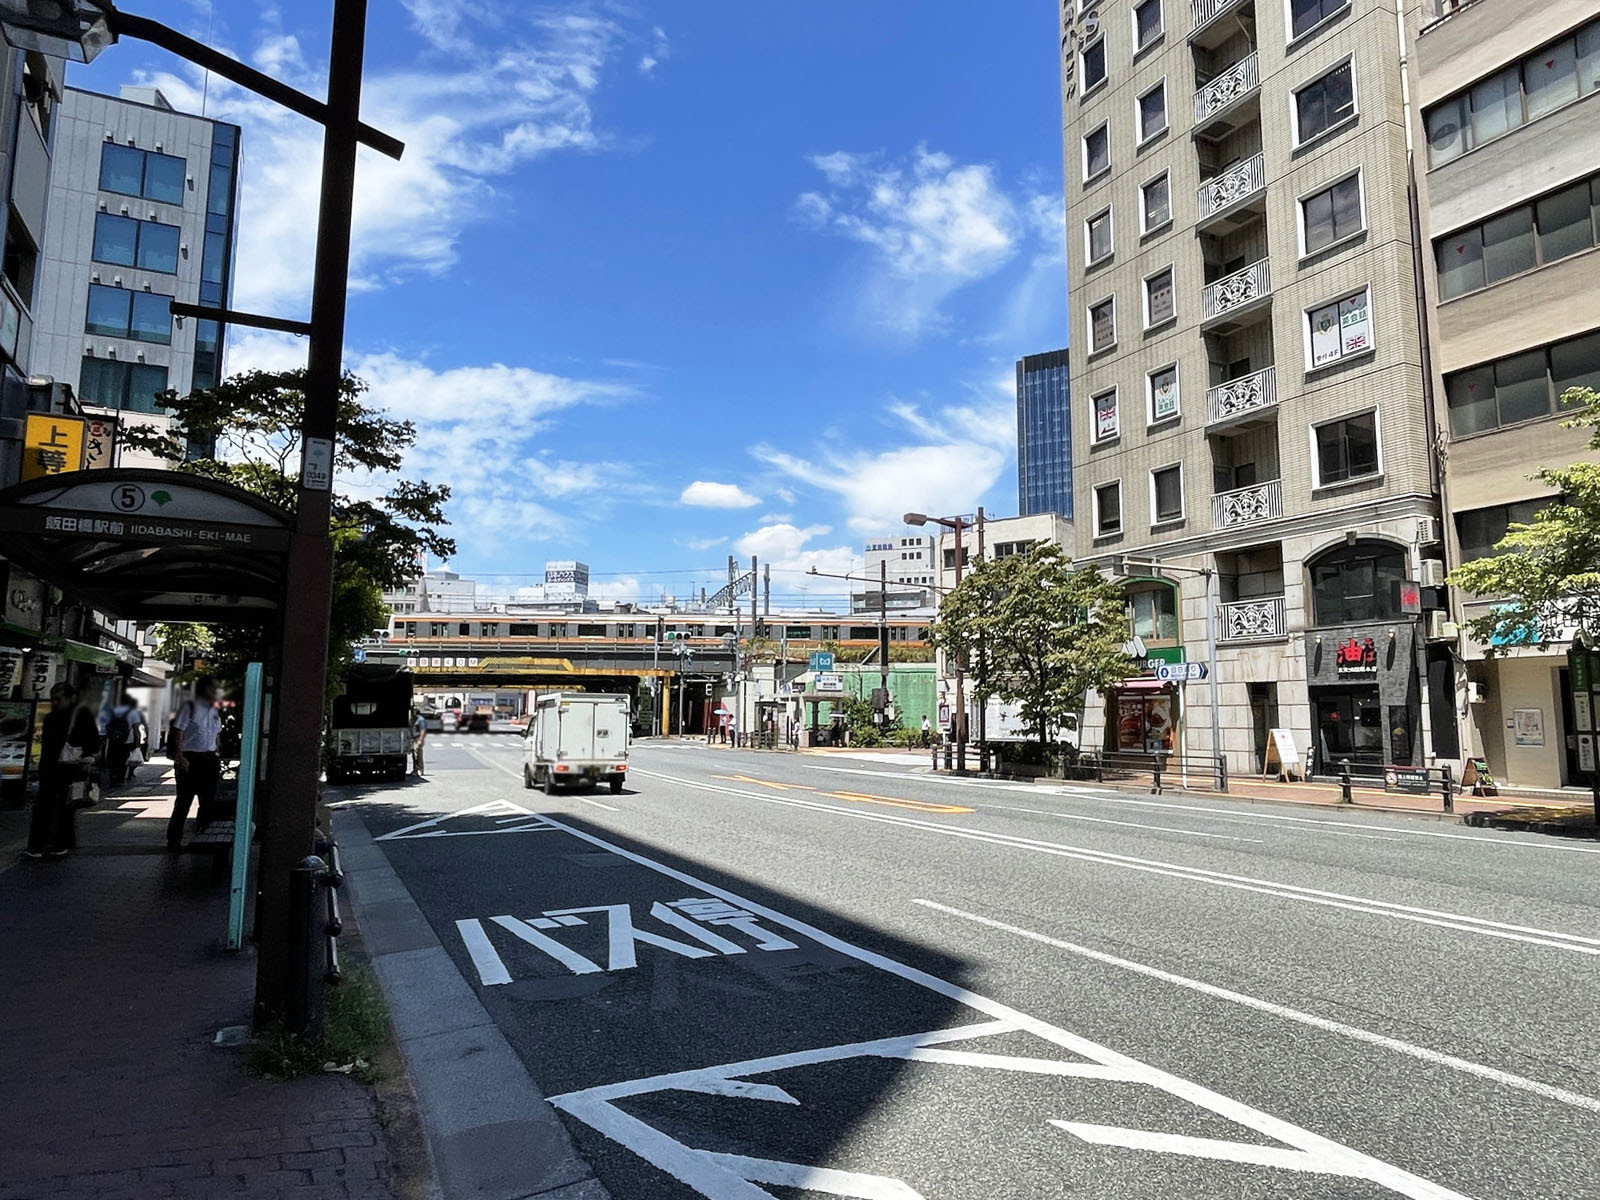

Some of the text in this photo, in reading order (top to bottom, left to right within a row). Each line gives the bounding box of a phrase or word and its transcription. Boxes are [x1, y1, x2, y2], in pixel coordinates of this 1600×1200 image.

[120, 488, 136, 509] 5
[45, 516, 125, 537] 飯田橋駅前
[130, 525, 253, 545] IIDABASHI-EKI-MAE
[454, 897, 800, 987] バス停
